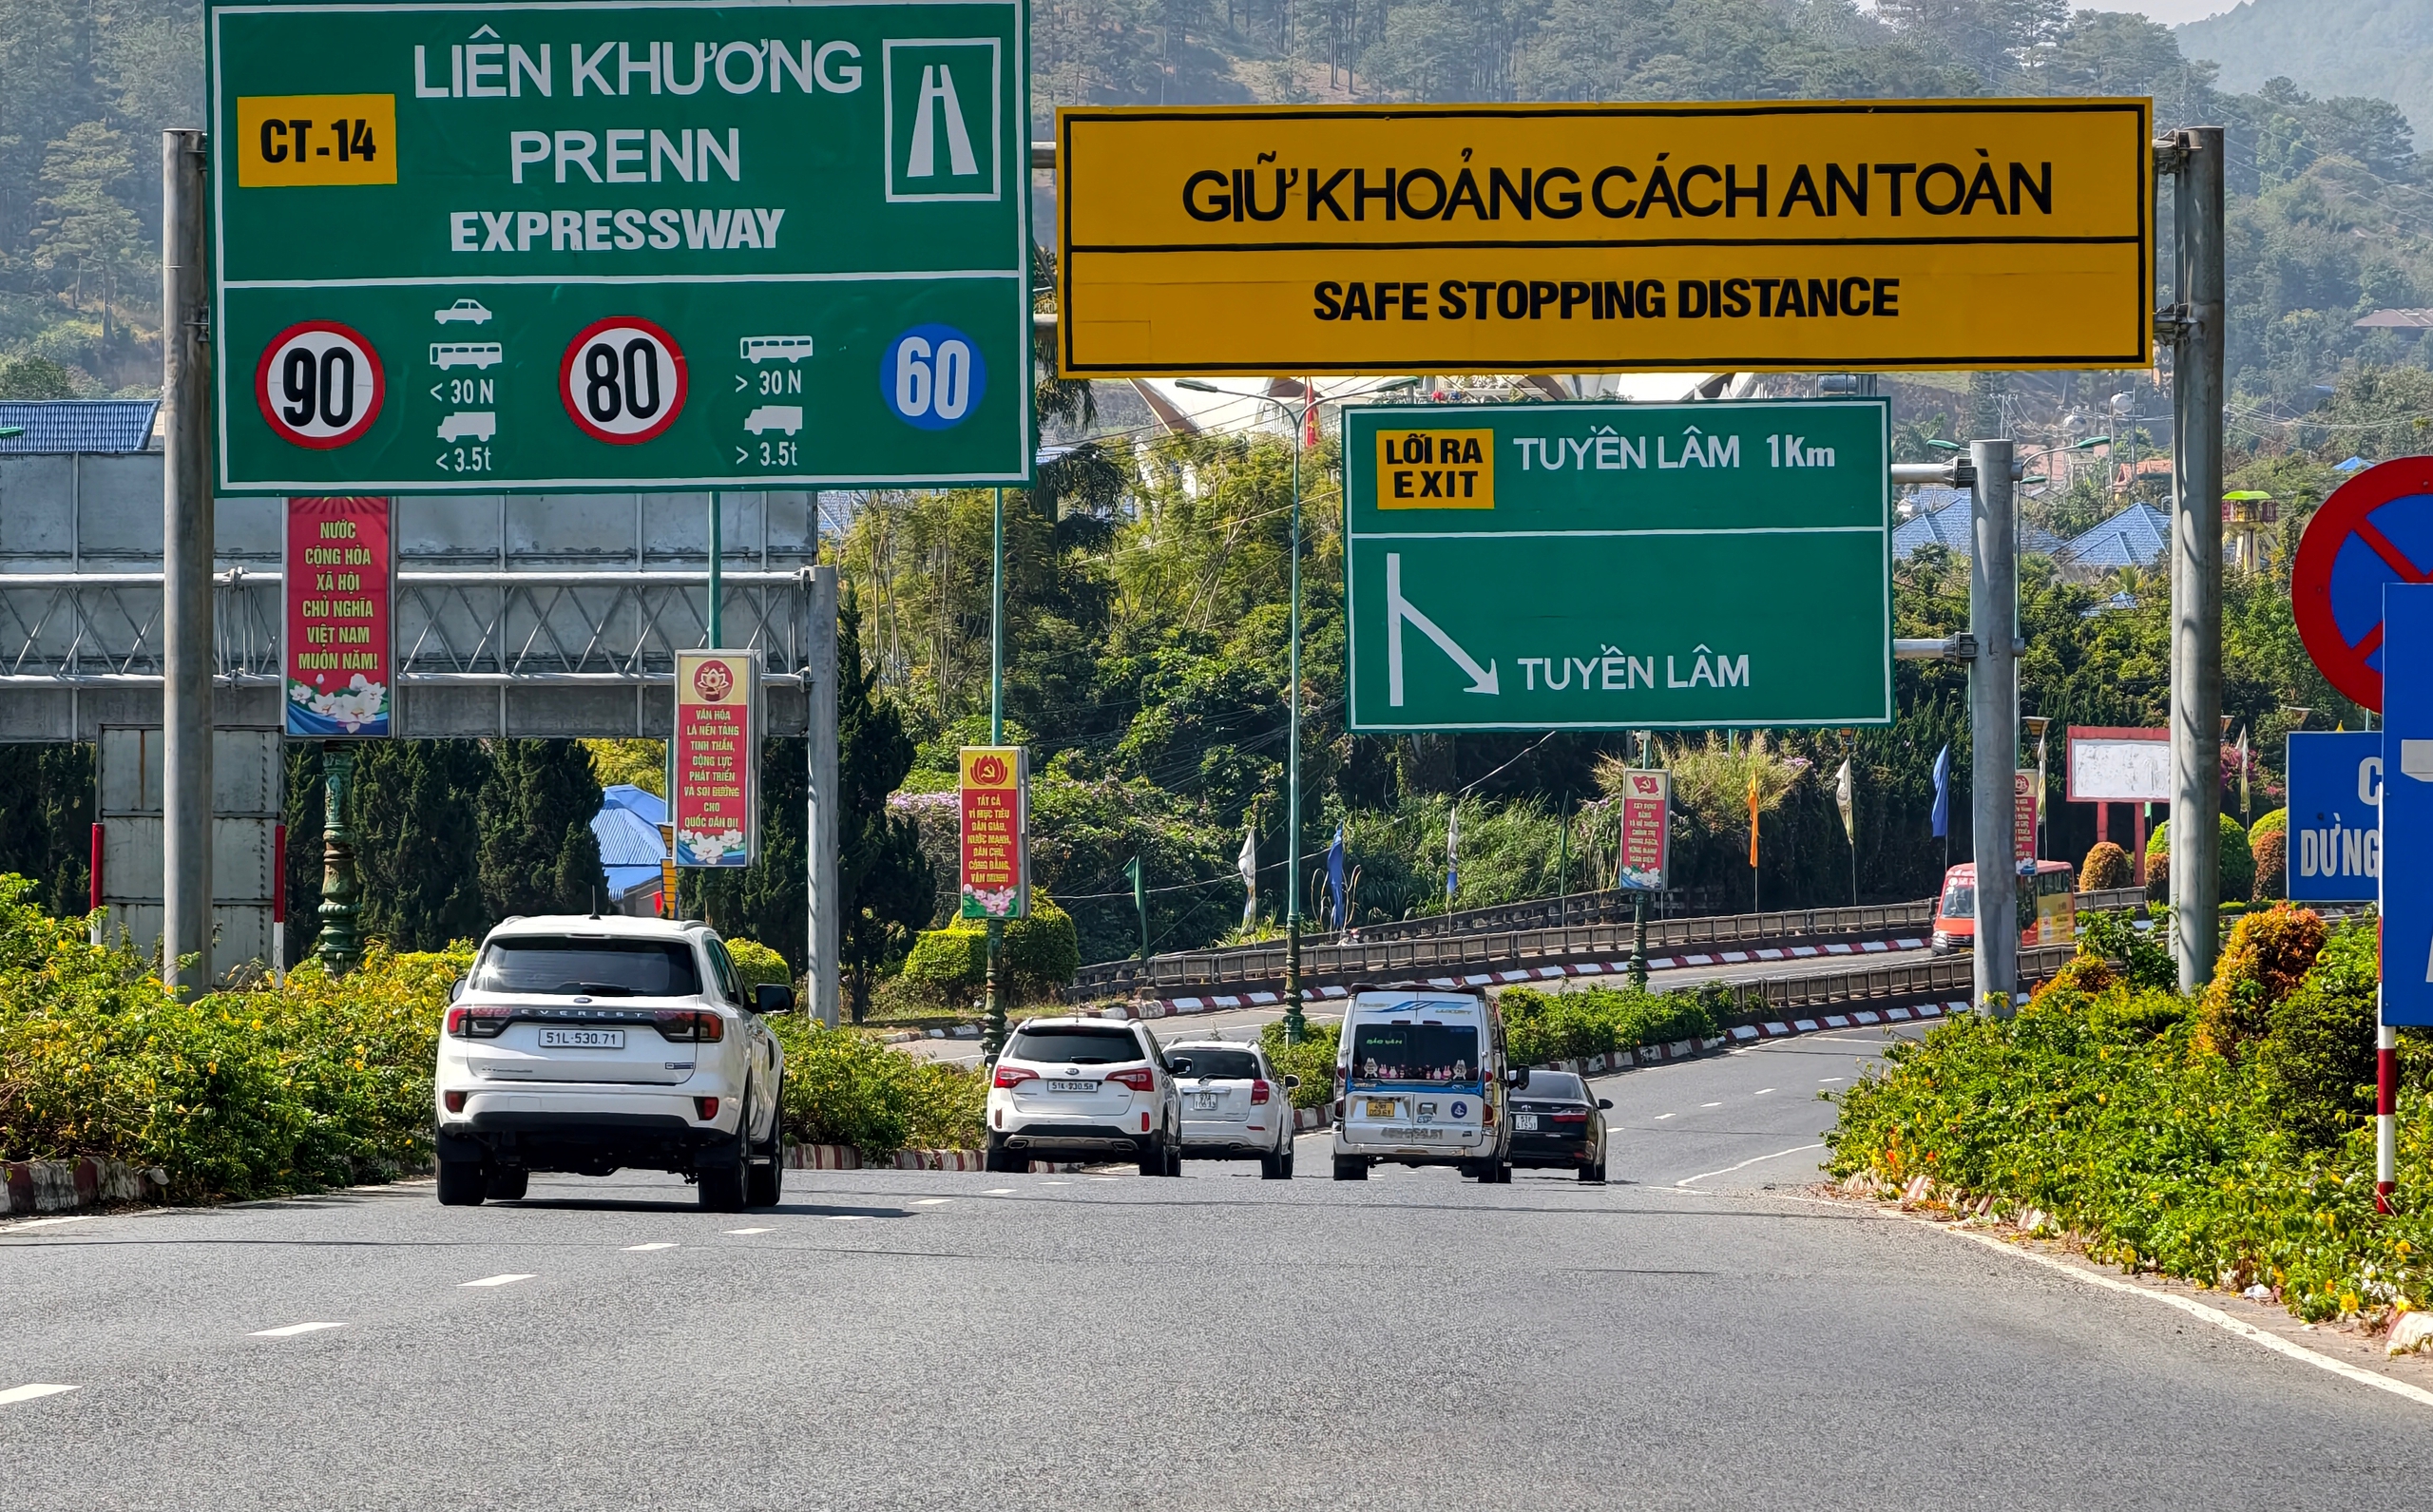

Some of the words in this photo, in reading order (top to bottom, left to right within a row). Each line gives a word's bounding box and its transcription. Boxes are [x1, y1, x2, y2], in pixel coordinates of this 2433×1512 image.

[414, 24, 552, 98] LIÊN
[571, 39, 862, 97] KHƯƠNG
[510, 127, 740, 184] PRENN
[1181, 150, 1302, 223] GIỮ
[1305, 146, 1583, 222] KHOẢNG
[1591, 151, 1768, 220] CÁCH
[450, 208, 785, 252] EXPRESSWAY
[1312, 280, 1429, 321] SAFE
[1438, 278, 1667, 321] STOPPING
[1677, 276, 1901, 319] DISTANCE
[281, 346, 354, 429] 90
[584, 337, 661, 423] 80
[896, 336, 970, 420] 60
[1385, 432, 1433, 466] LỐI
[1440, 437, 1484, 465] RA
[1513, 425, 1647, 470] TUYỀN
[1657, 425, 1740, 469] LÂM
[1766, 433, 1836, 468] 1Km
[1393, 470, 1479, 499] EXIT
[319, 519, 356, 539] NƯỚC
[305, 545, 341, 568] CỘNG
[345, 545, 372, 565] HÒA
[316, 570, 334, 591] XÃ
[337, 572, 360, 595] HỘI
[302, 595, 330, 618] CHỦ
[333, 597, 374, 618] NGHĨA
[306, 623, 335, 647] VIỆT
[338, 626, 370, 643] NAM
[298, 649, 338, 670] MUÔN
[342, 649, 378, 670] NĂM!
[1517, 643, 1655, 691] TUYỀN
[1667, 643, 1750, 688] LÂM
[697, 786, 710, 796] SOI
[703, 802, 720, 812] CHO
[2300, 812, 2379, 878] DỪNG
[520, 1009, 644, 1019] EVEREST
[546, 1031, 617, 1045] 51L-530.71
